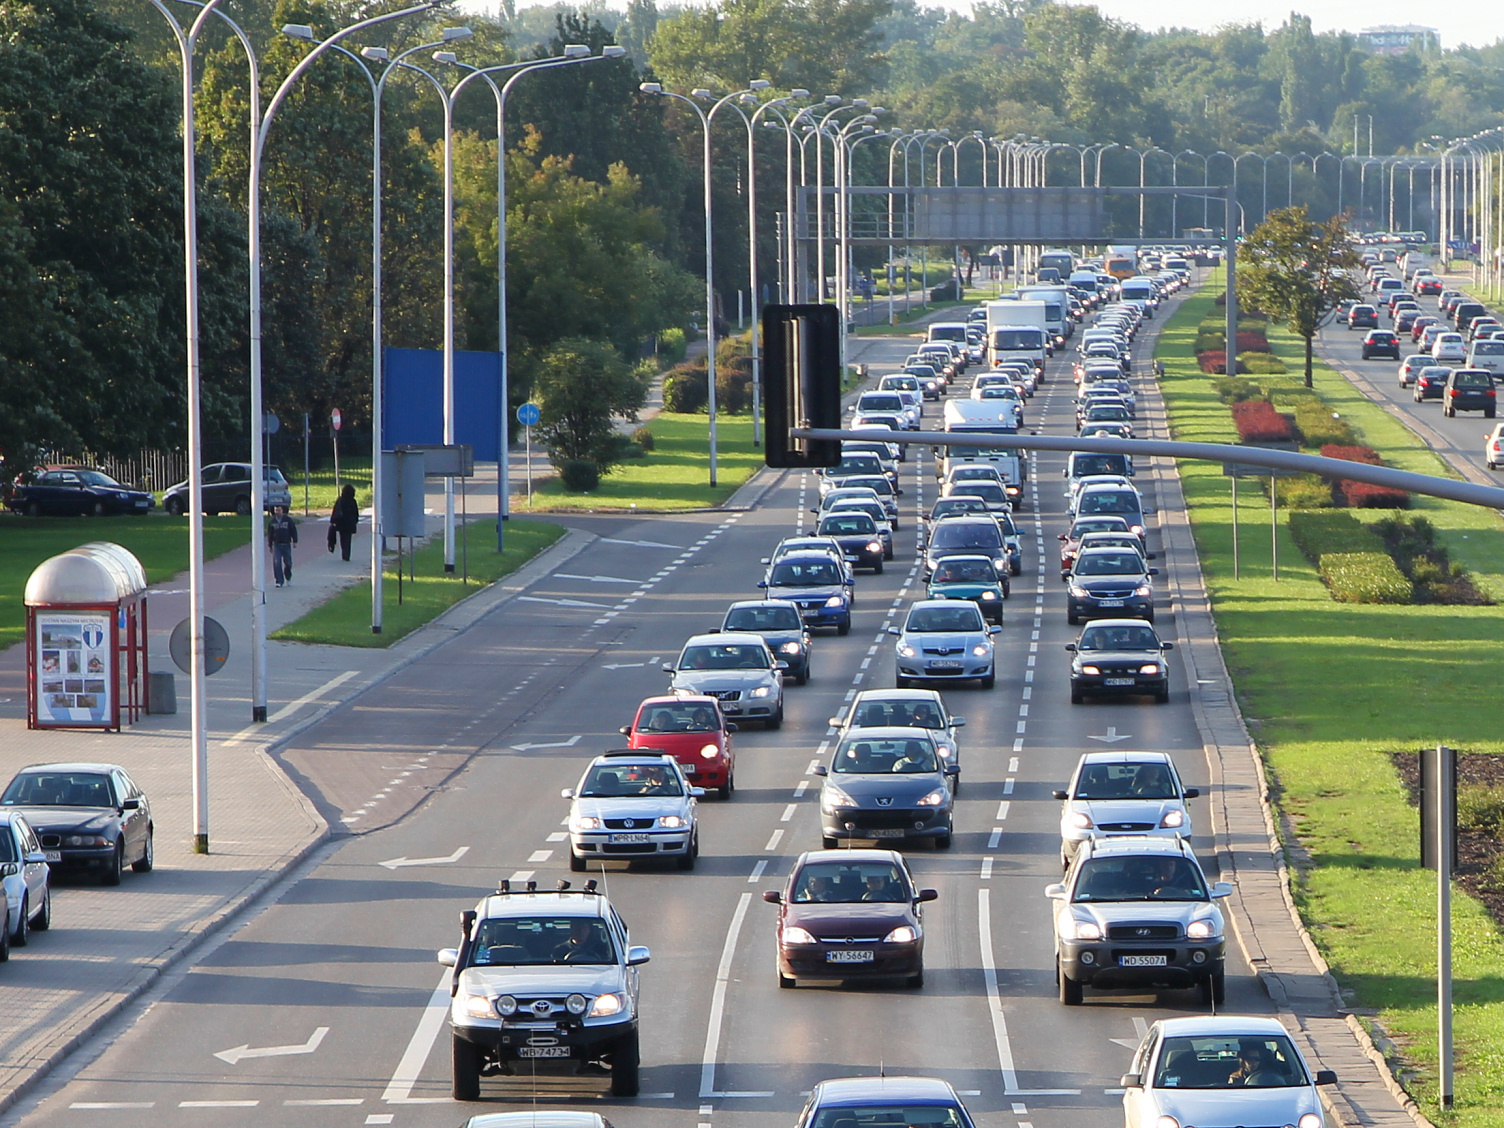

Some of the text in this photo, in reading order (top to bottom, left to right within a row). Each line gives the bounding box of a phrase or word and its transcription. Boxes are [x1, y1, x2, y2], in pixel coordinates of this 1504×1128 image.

[612, 834, 648, 842] WPR LN64
[831, 951, 873, 960] WY 56647
[1124, 957, 1166, 966] WD 5507A
[522, 1047, 569, 1056] WB 74734
